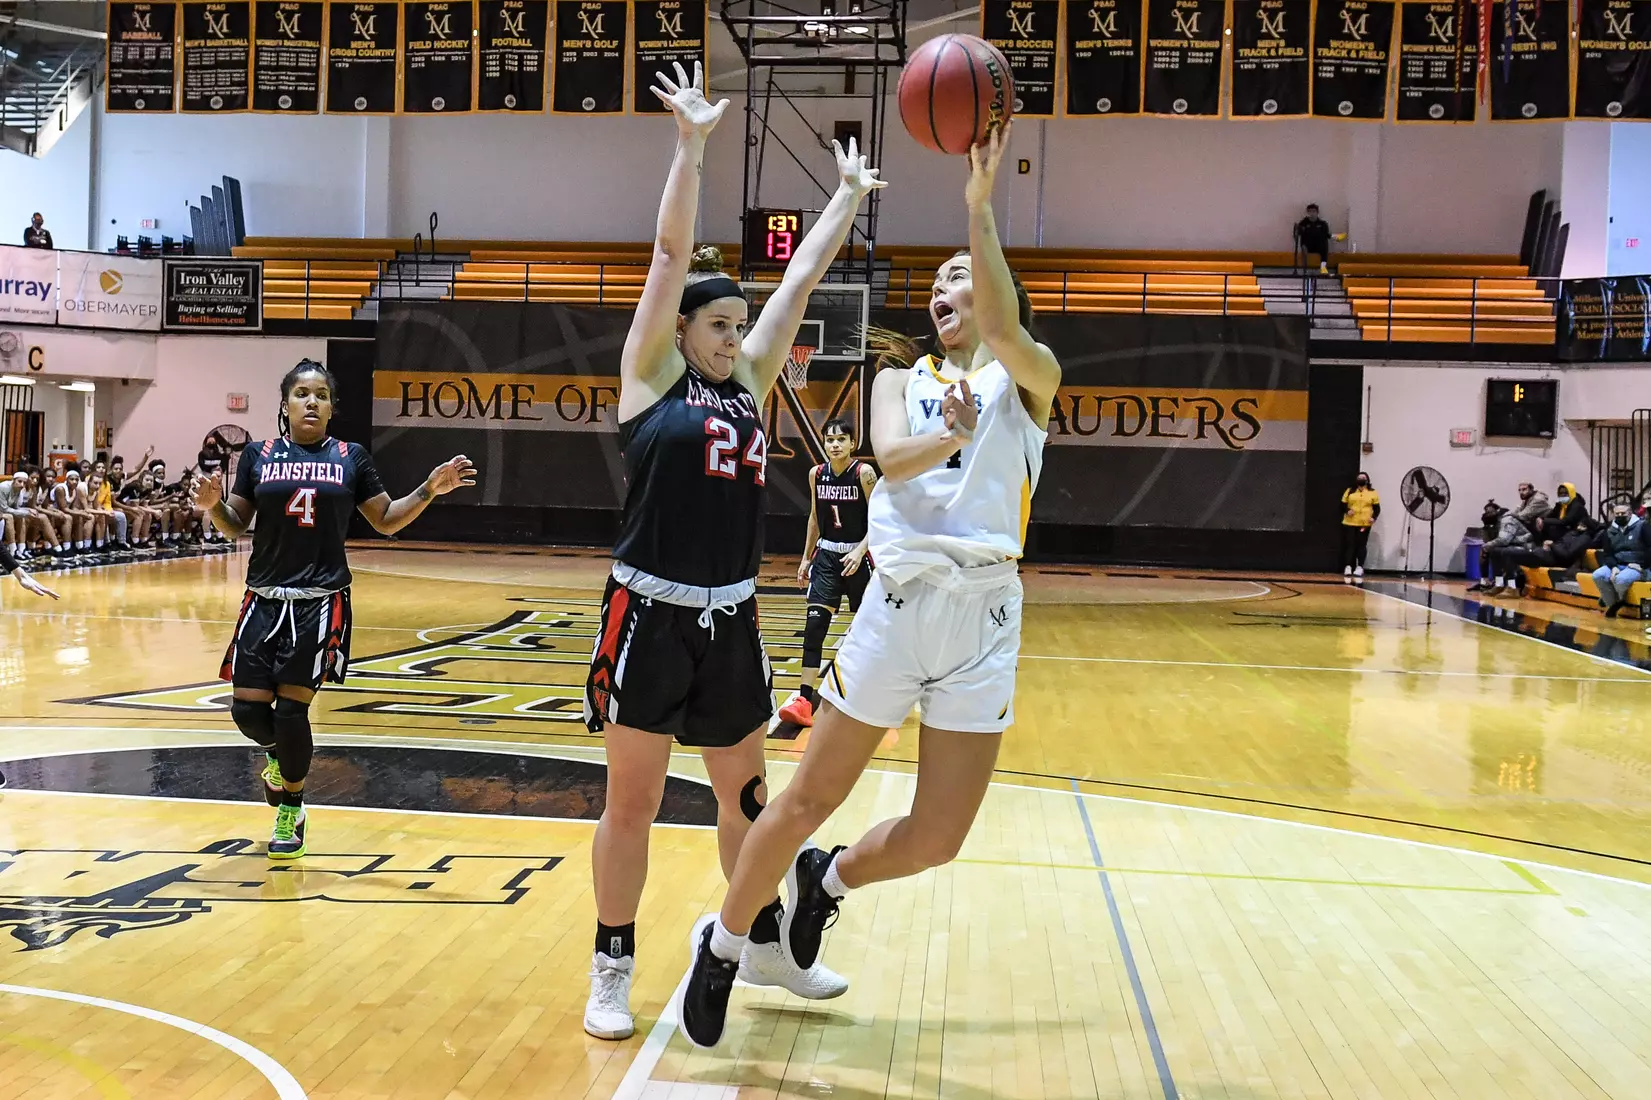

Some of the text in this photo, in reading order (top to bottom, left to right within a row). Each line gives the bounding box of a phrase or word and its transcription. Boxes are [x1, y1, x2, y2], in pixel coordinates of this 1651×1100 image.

[351, 41, 375, 49] MEN'S
[409, 40, 469, 49] FIELD HOCKEY
[492, 38, 532, 47] FOOTBALL
[563, 40, 619, 48] MEN'S GOLF
[1016, 40, 1053, 48] SOCCER
[1076, 39, 1132, 48] MEN'S TENNIS
[1190, 40, 1220, 48] TENNIS
[1330, 40, 1374, 49] WOMEN'S
[1580, 40, 1651, 50] WOMEN'S GOL
[1239, 49, 1266, 57] TRACK
[1278, 48, 1304, 56] FIELD
[1317, 49, 1347, 57] TRACK
[1358, 51, 1385, 59] FIELD
[1018, 159, 1030, 174] D
[768, 215, 797, 231] 1:37
[767, 232, 792, 259] 13
[180, 272, 245, 287] Iron Valley
[0, 279, 52, 301] rray
[64, 299, 158, 317] OBERMAYER
[178, 304, 205, 314] Buying
[216, 305, 247, 315] Selling?
[28, 346, 43, 371] C
[396, 377, 618, 424] HOME OF
[1047, 394, 1262, 449] AUDERS
[705, 416, 767, 487] 24
[260, 462, 344, 485] MANSFIELD
[816, 485, 859, 500] MANSFIELD
[285, 488, 317, 527] 4
[829, 504, 843, 529] 1
